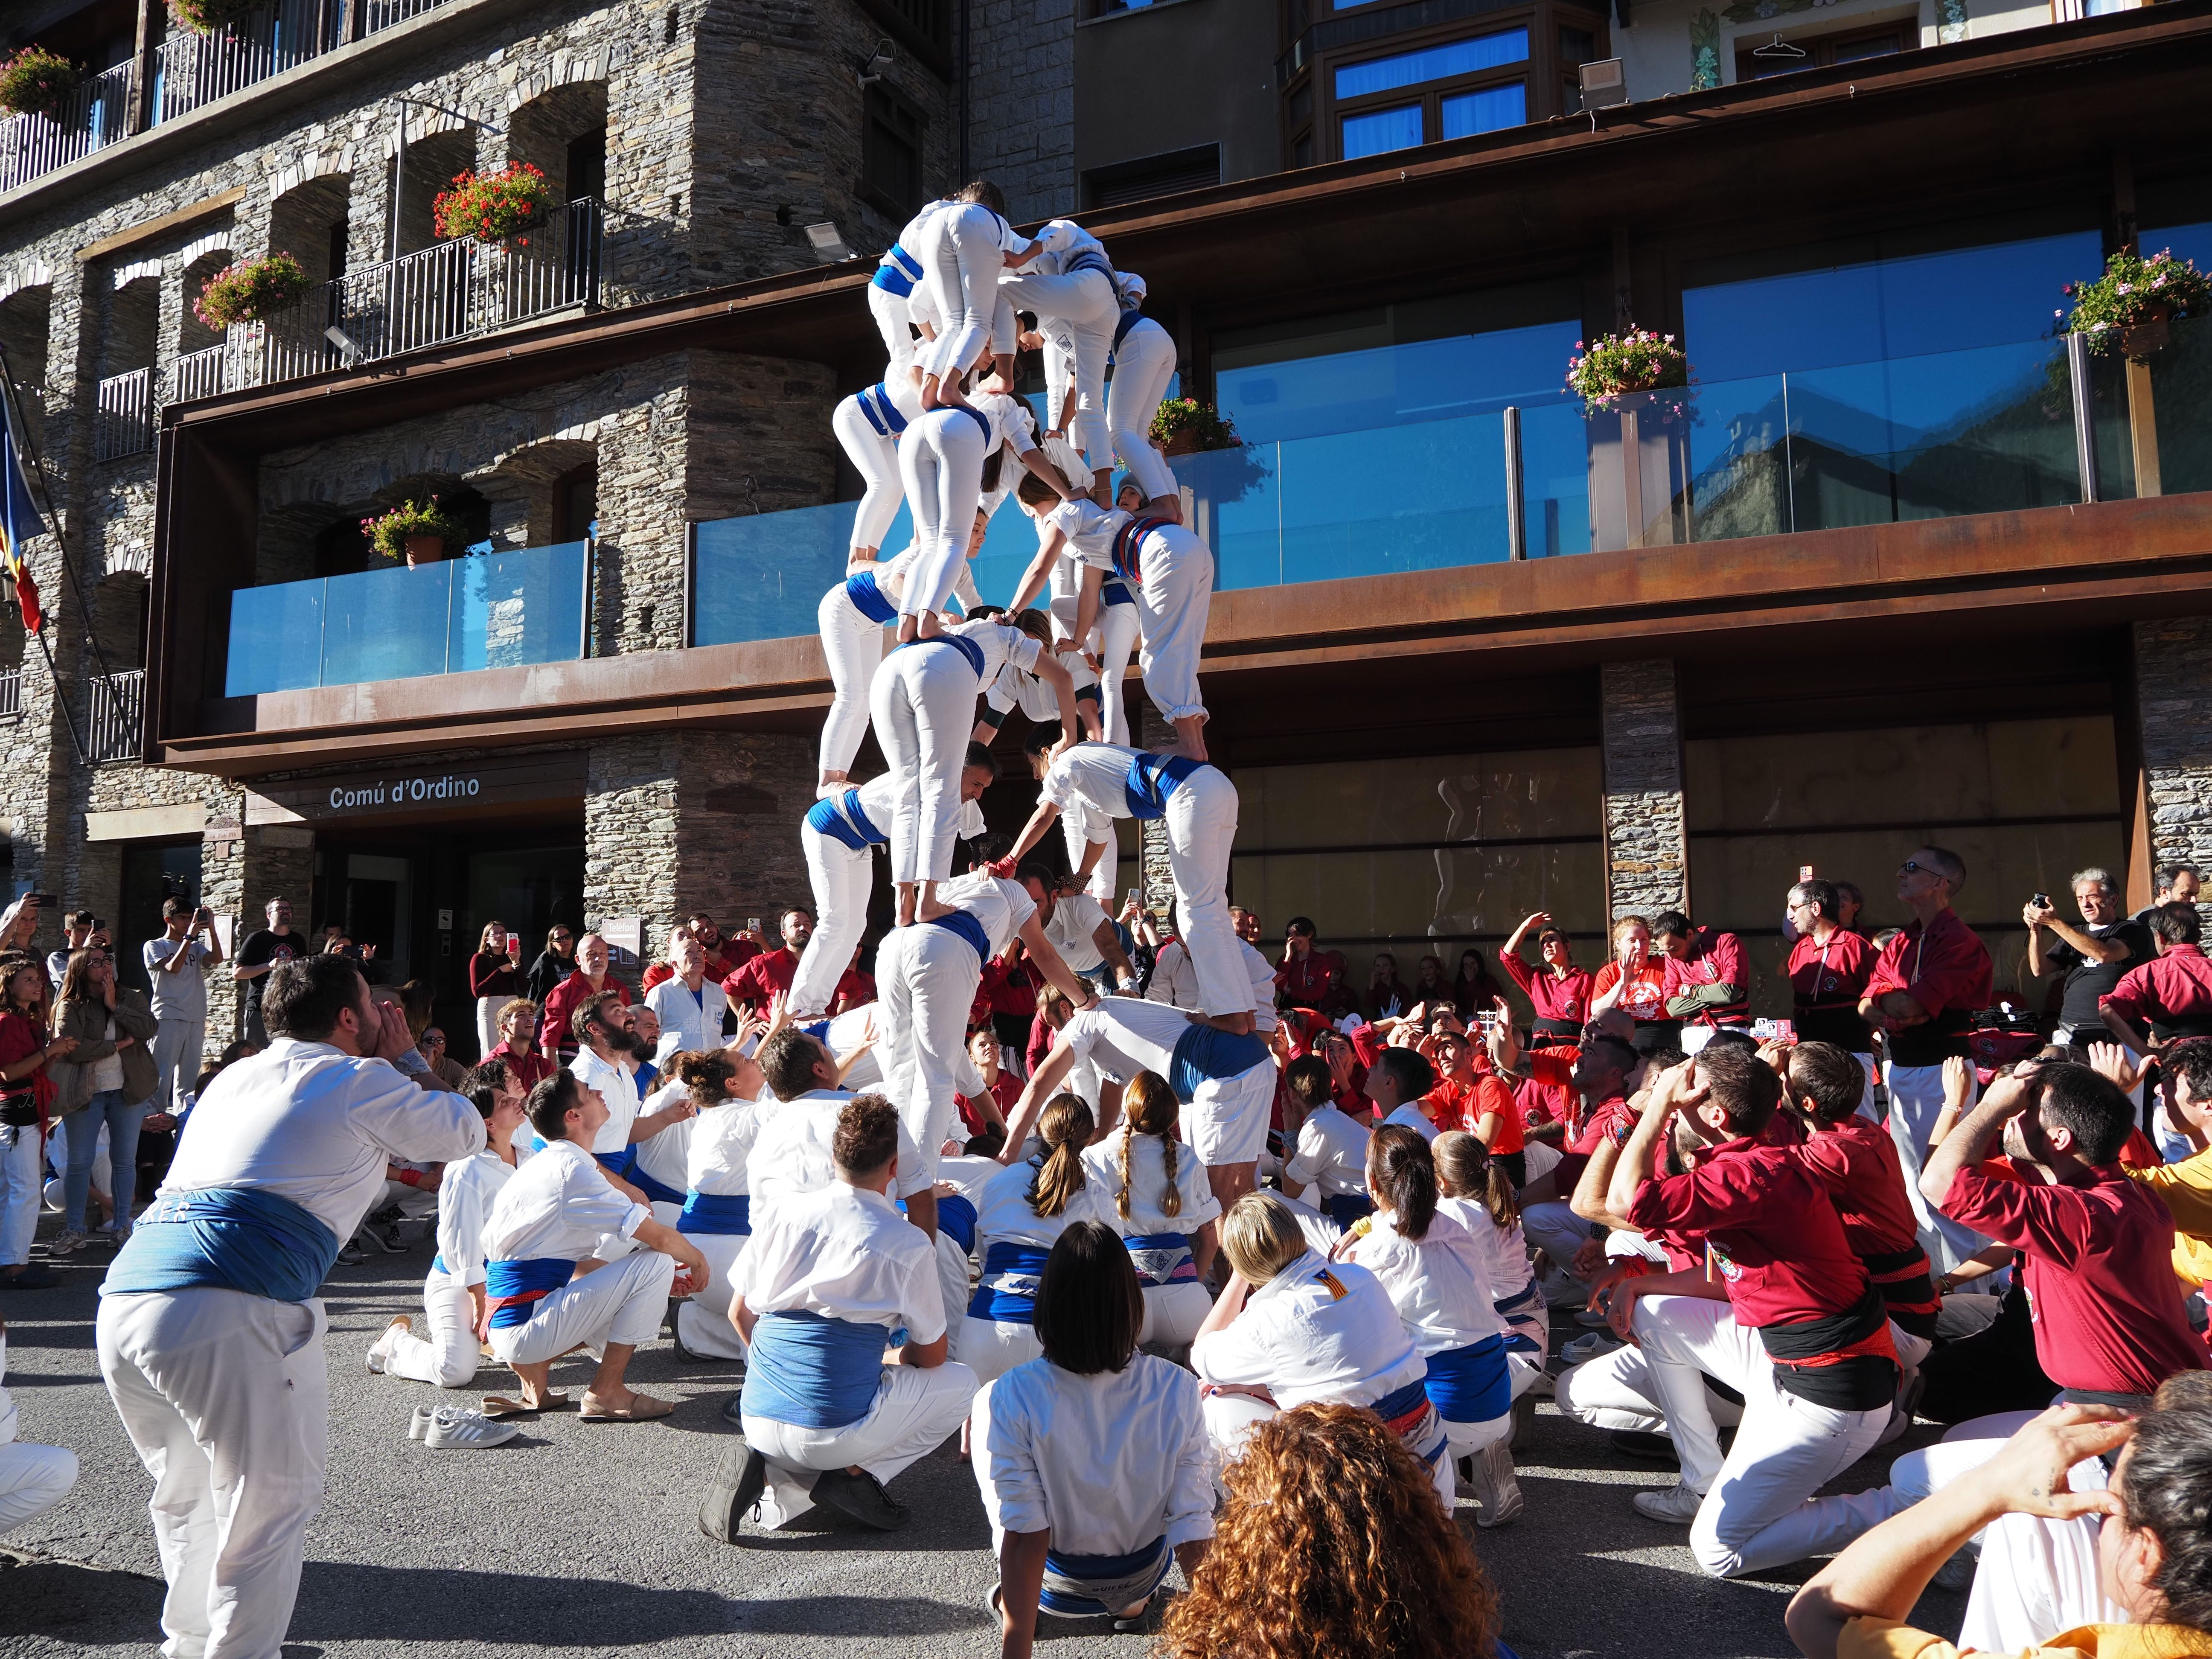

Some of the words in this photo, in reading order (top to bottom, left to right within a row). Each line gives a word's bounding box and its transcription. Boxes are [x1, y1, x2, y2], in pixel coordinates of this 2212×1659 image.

[330, 781, 384, 808] Comú
[608, 923, 634, 931] Telèfon
[1619, 981, 1640, 1005] CASTELLERS
[1711, 1241, 1732, 1253] 'ANDORRA
